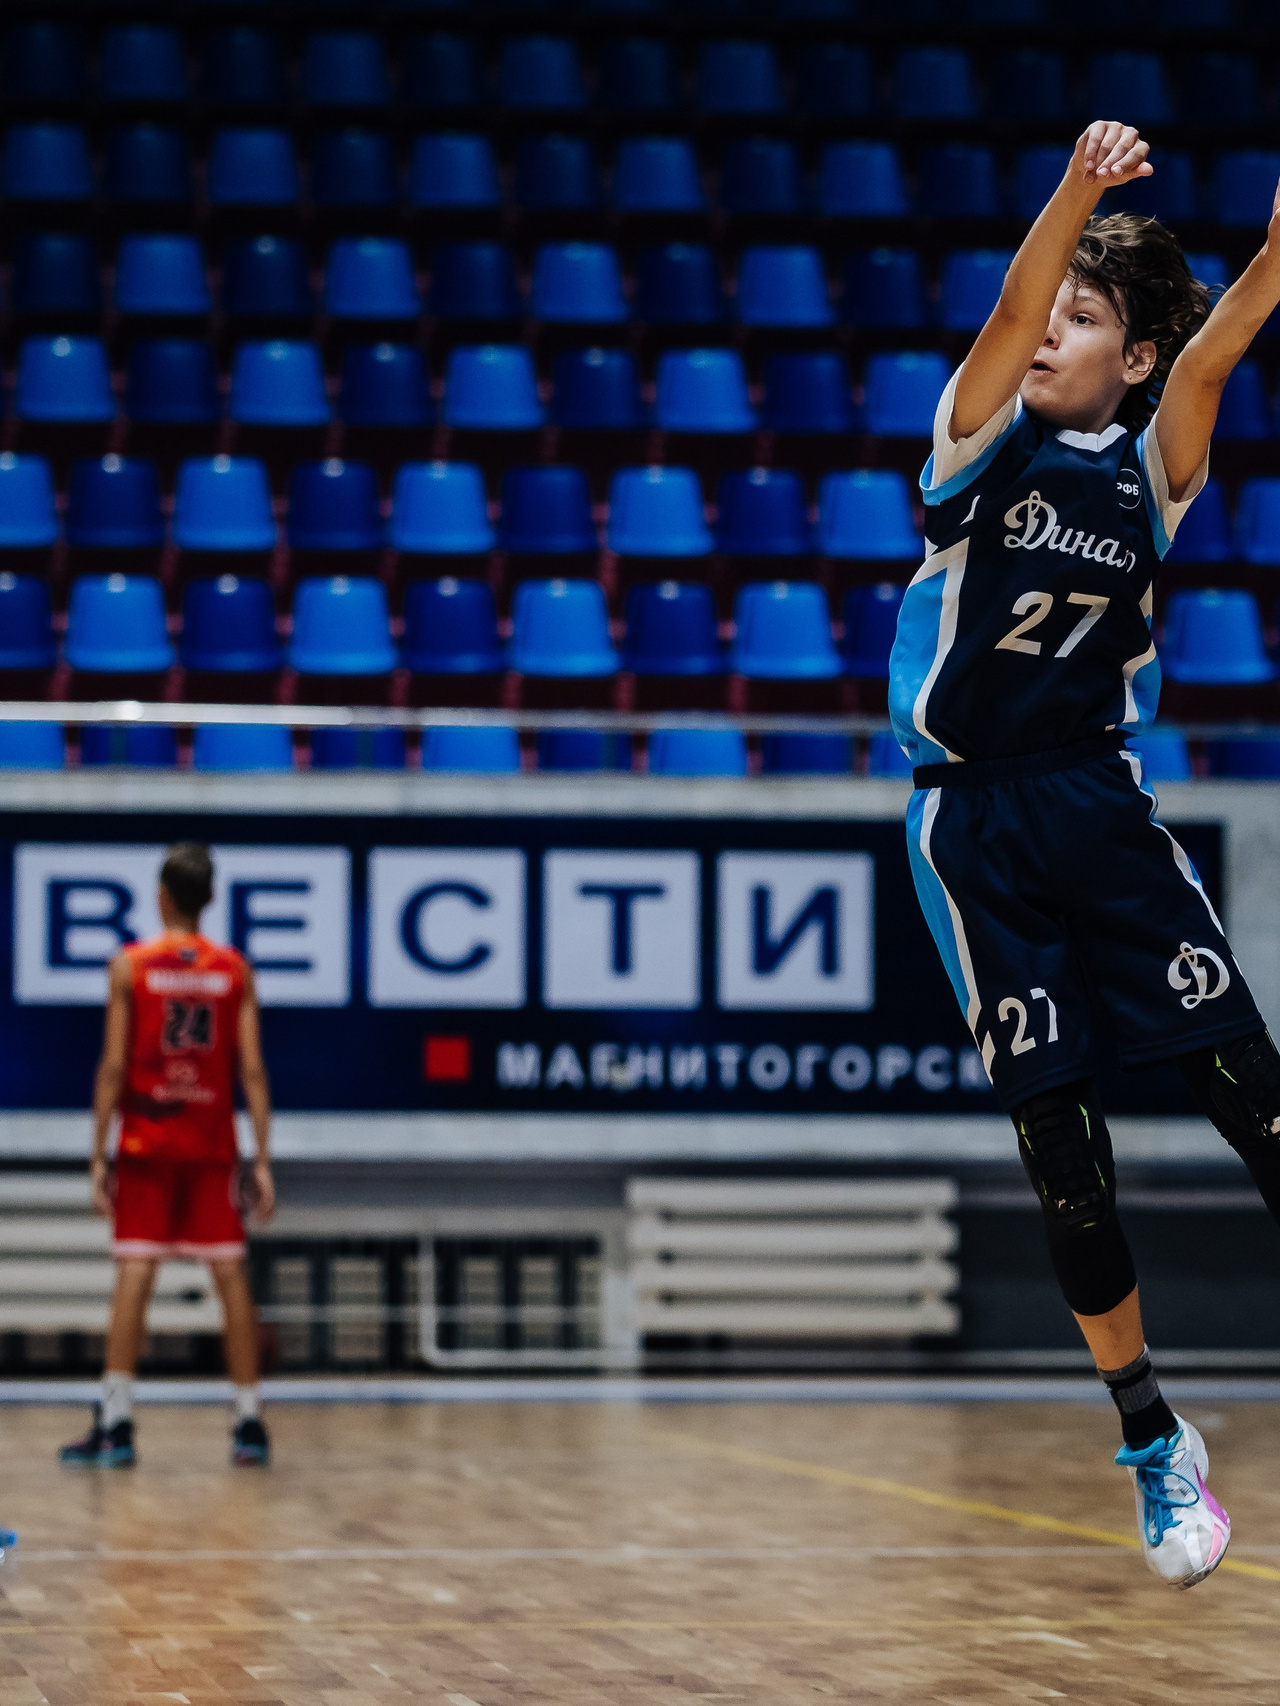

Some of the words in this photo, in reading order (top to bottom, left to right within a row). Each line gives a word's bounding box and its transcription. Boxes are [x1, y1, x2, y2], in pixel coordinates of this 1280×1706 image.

[1003, 490, 1136, 573] Дина
[994, 591, 1110, 658] 27
[46, 878, 842, 979] ВЕСТИ
[998, 988, 1058, 1056] 27
